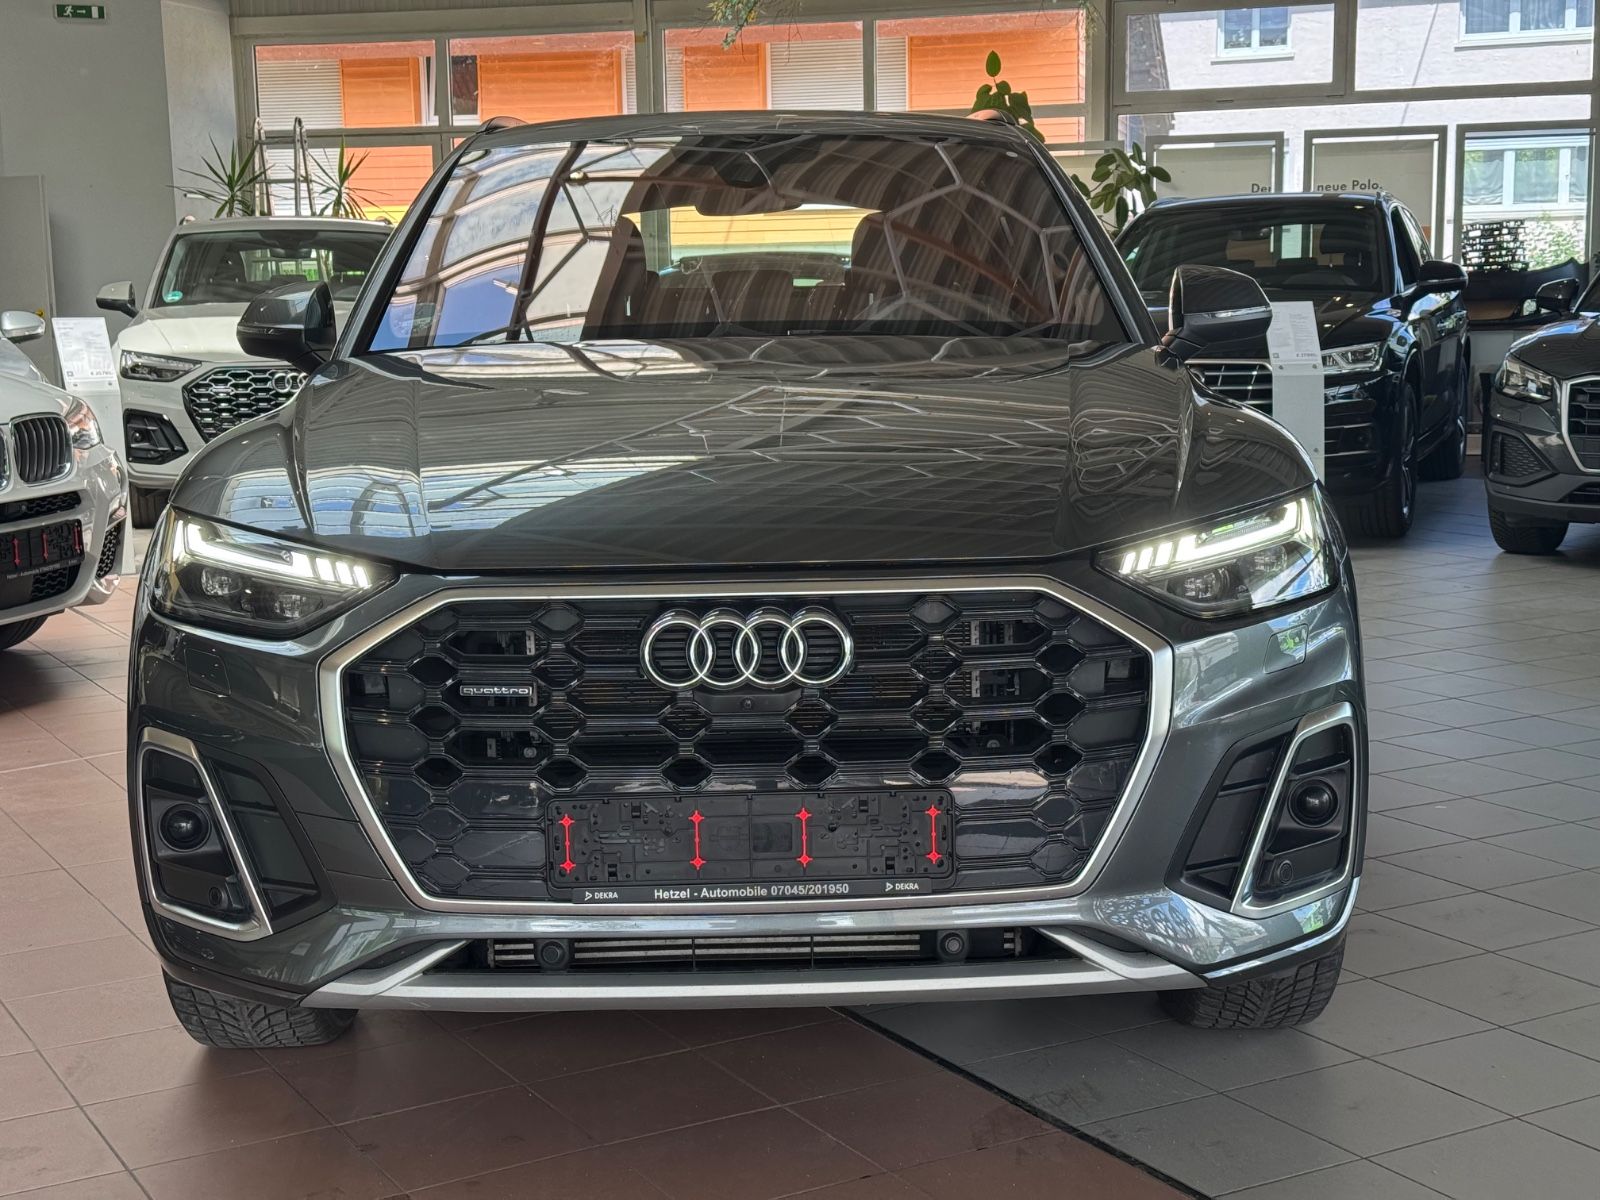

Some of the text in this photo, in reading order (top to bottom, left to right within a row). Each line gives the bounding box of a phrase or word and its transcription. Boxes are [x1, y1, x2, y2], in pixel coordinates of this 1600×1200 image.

[1317, 183, 1347, 192] neue
[1351, 179, 1383, 191] Polo.
[463, 687, 529, 695] quattro
[654, 888, 690, 899] Hetzel
[700, 886, 768, 898] Automobile
[770, 883, 849, 896] 07045/201950
[895, 882, 919, 891] DEKRA
[594, 891, 619, 900] DEKRA
